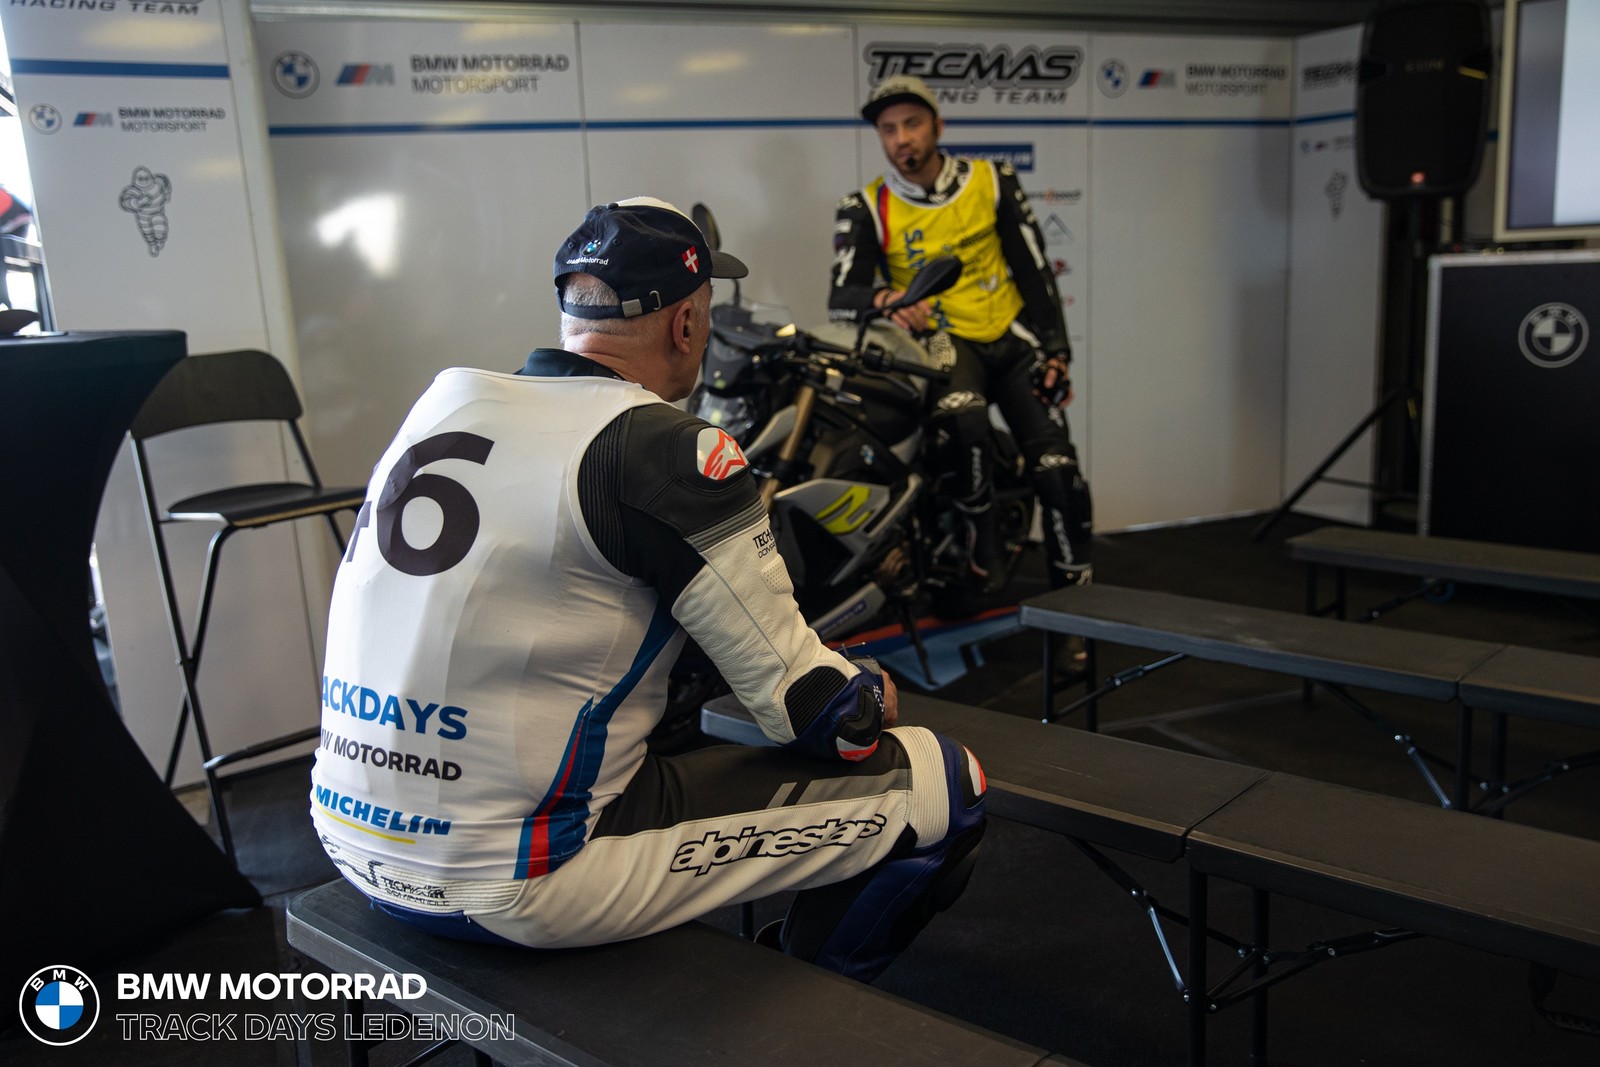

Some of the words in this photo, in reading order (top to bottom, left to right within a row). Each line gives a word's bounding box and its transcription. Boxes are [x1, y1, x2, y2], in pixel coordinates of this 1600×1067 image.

[129, 2, 199, 16] TEAM
[410, 54, 459, 72] BMW
[462, 54, 570, 72] MOTORRAD
[868, 47, 1080, 83] TECMAS
[411, 74, 541, 93] MOTORSPORT
[995, 89, 1068, 105] TEAM
[118, 106, 153, 119] BMW
[155, 107, 226, 120] MOTORRAD
[120, 121, 207, 133] MOTORSPORT
[580, 256, 609, 266] Motorrad
[333, 735, 463, 782] MOTORRAD
[314, 783, 453, 836] MICHELIN
[670, 813, 888, 878] alpinestars
